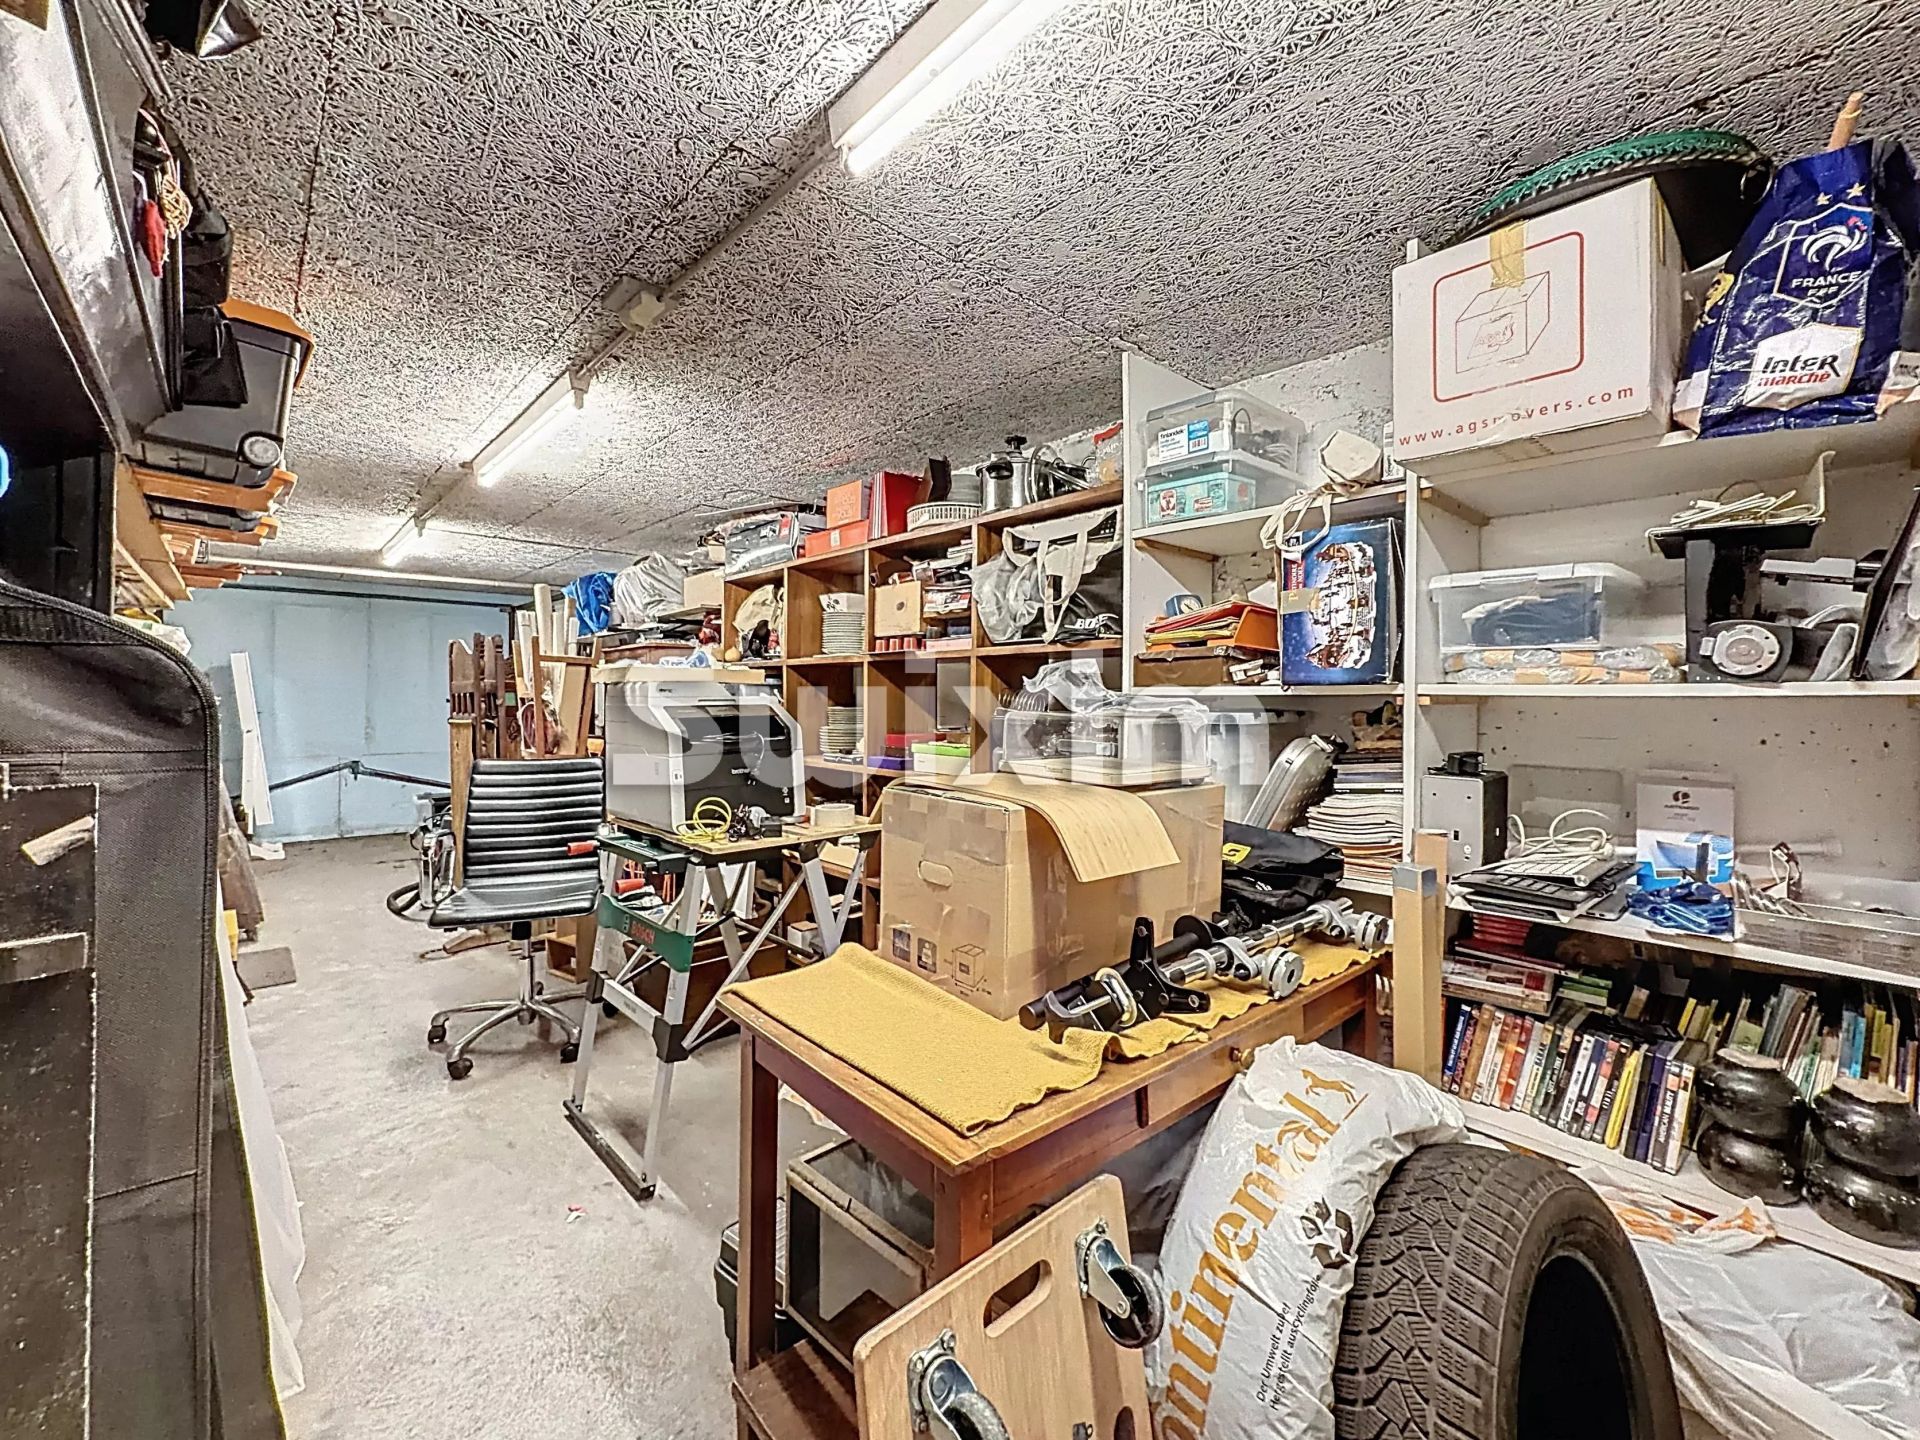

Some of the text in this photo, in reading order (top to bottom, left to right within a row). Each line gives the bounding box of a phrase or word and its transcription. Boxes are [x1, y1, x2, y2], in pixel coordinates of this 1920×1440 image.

[1791, 270, 1862, 288] FRANCE
[1161, 1092, 1341, 1440] ntinental
[1260, 1335, 1282, 1379] Umwelt
[1256, 1379, 1268, 1402] Der
